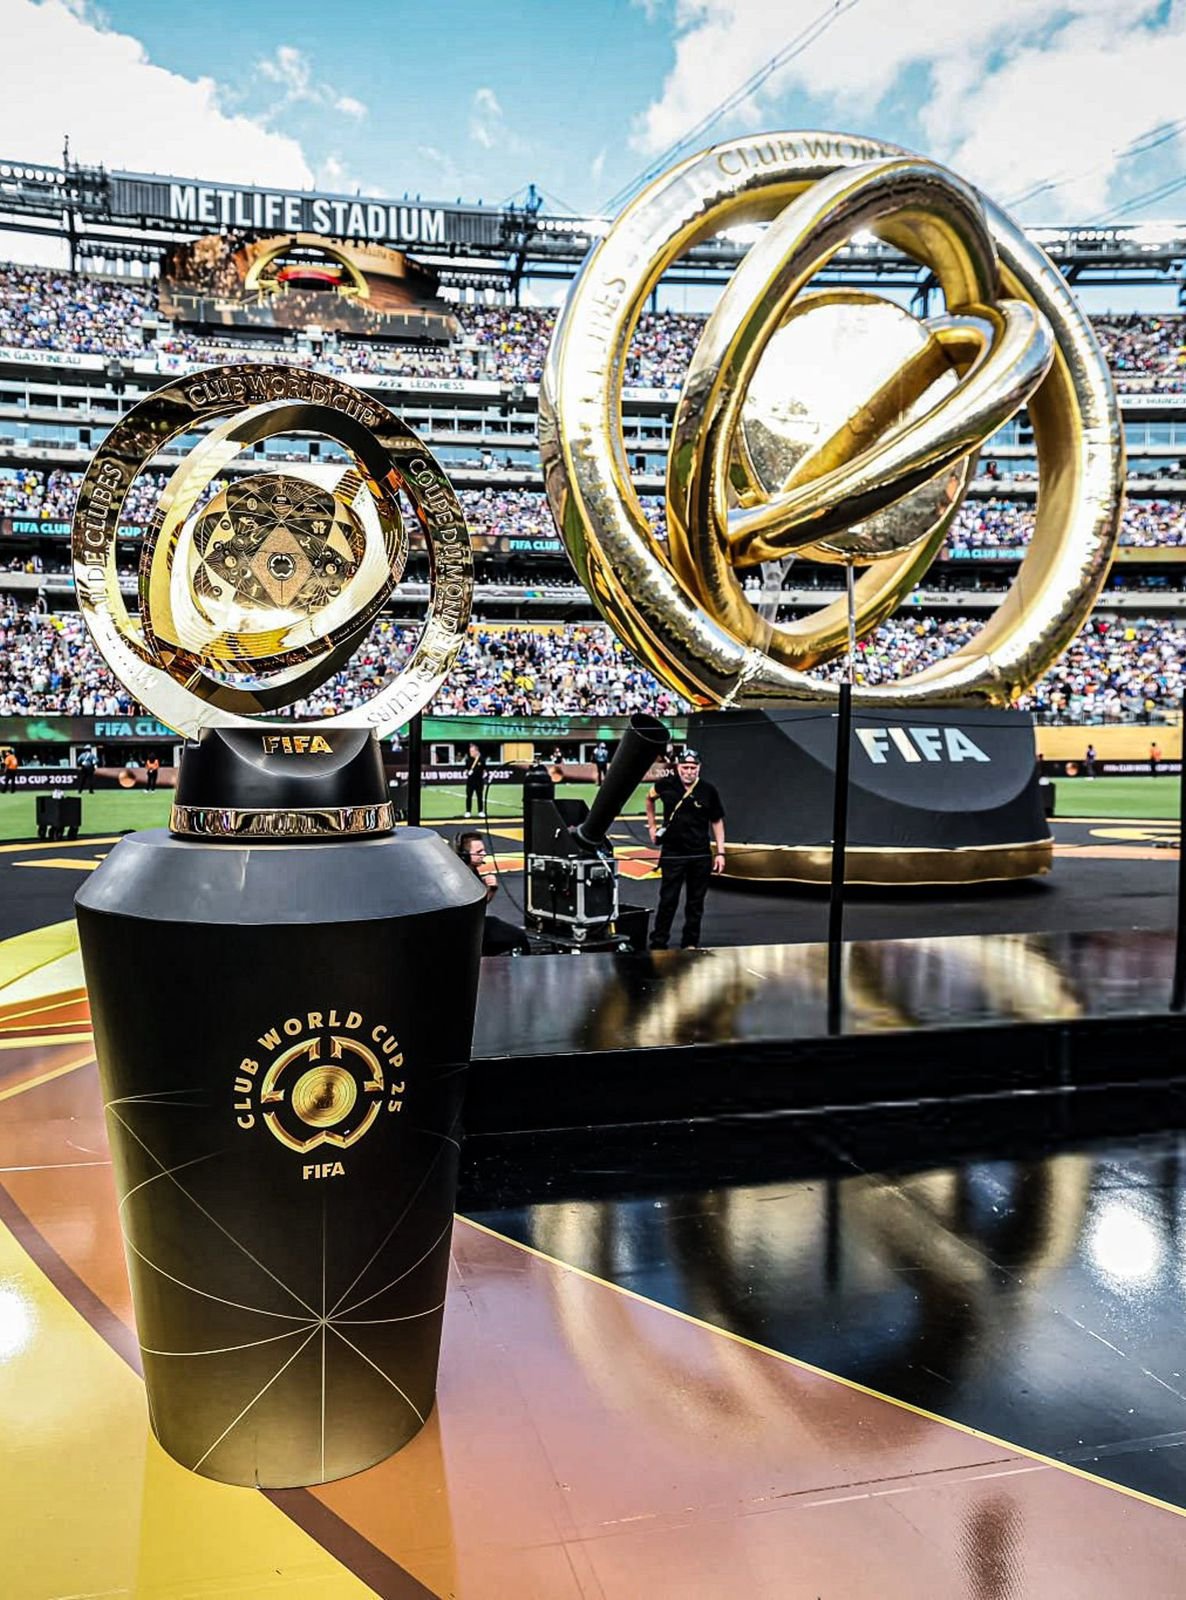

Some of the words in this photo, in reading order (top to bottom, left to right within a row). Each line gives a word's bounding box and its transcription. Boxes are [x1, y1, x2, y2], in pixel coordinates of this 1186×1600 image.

[169, 184, 303, 232] METLIFE
[312, 199, 446, 244] STADIUM
[189, 375, 247, 406] CLUB
[249, 374, 331, 404] WORLD
[332, 393, 381, 428] CUP
[85, 463, 123, 547] CLUBES
[408, 458, 454, 526] COUPE
[12, 521, 39, 533] FIFA
[40, 523, 71, 534] CLUB
[117, 526, 142, 537] CUP
[509, 540, 533, 550] FIFA
[533, 540, 560, 551] CLUB
[94, 722, 132, 736] FIFA
[483, 722, 529, 736] FINAL
[532, 721, 570, 736] 2025
[262, 736, 333, 753] FIFA
[855, 727, 992, 764] FIFA
[28, 774, 48, 785] CUP
[420, 770, 438, 780] LUB
[257, 1009, 363, 1051] WORLD
[371, 1025, 404, 1068] CUP
[233, 1057, 259, 1130] CLUB
[387, 1080, 406, 1113] 25
[302, 1161, 346, 1180] FIFA
